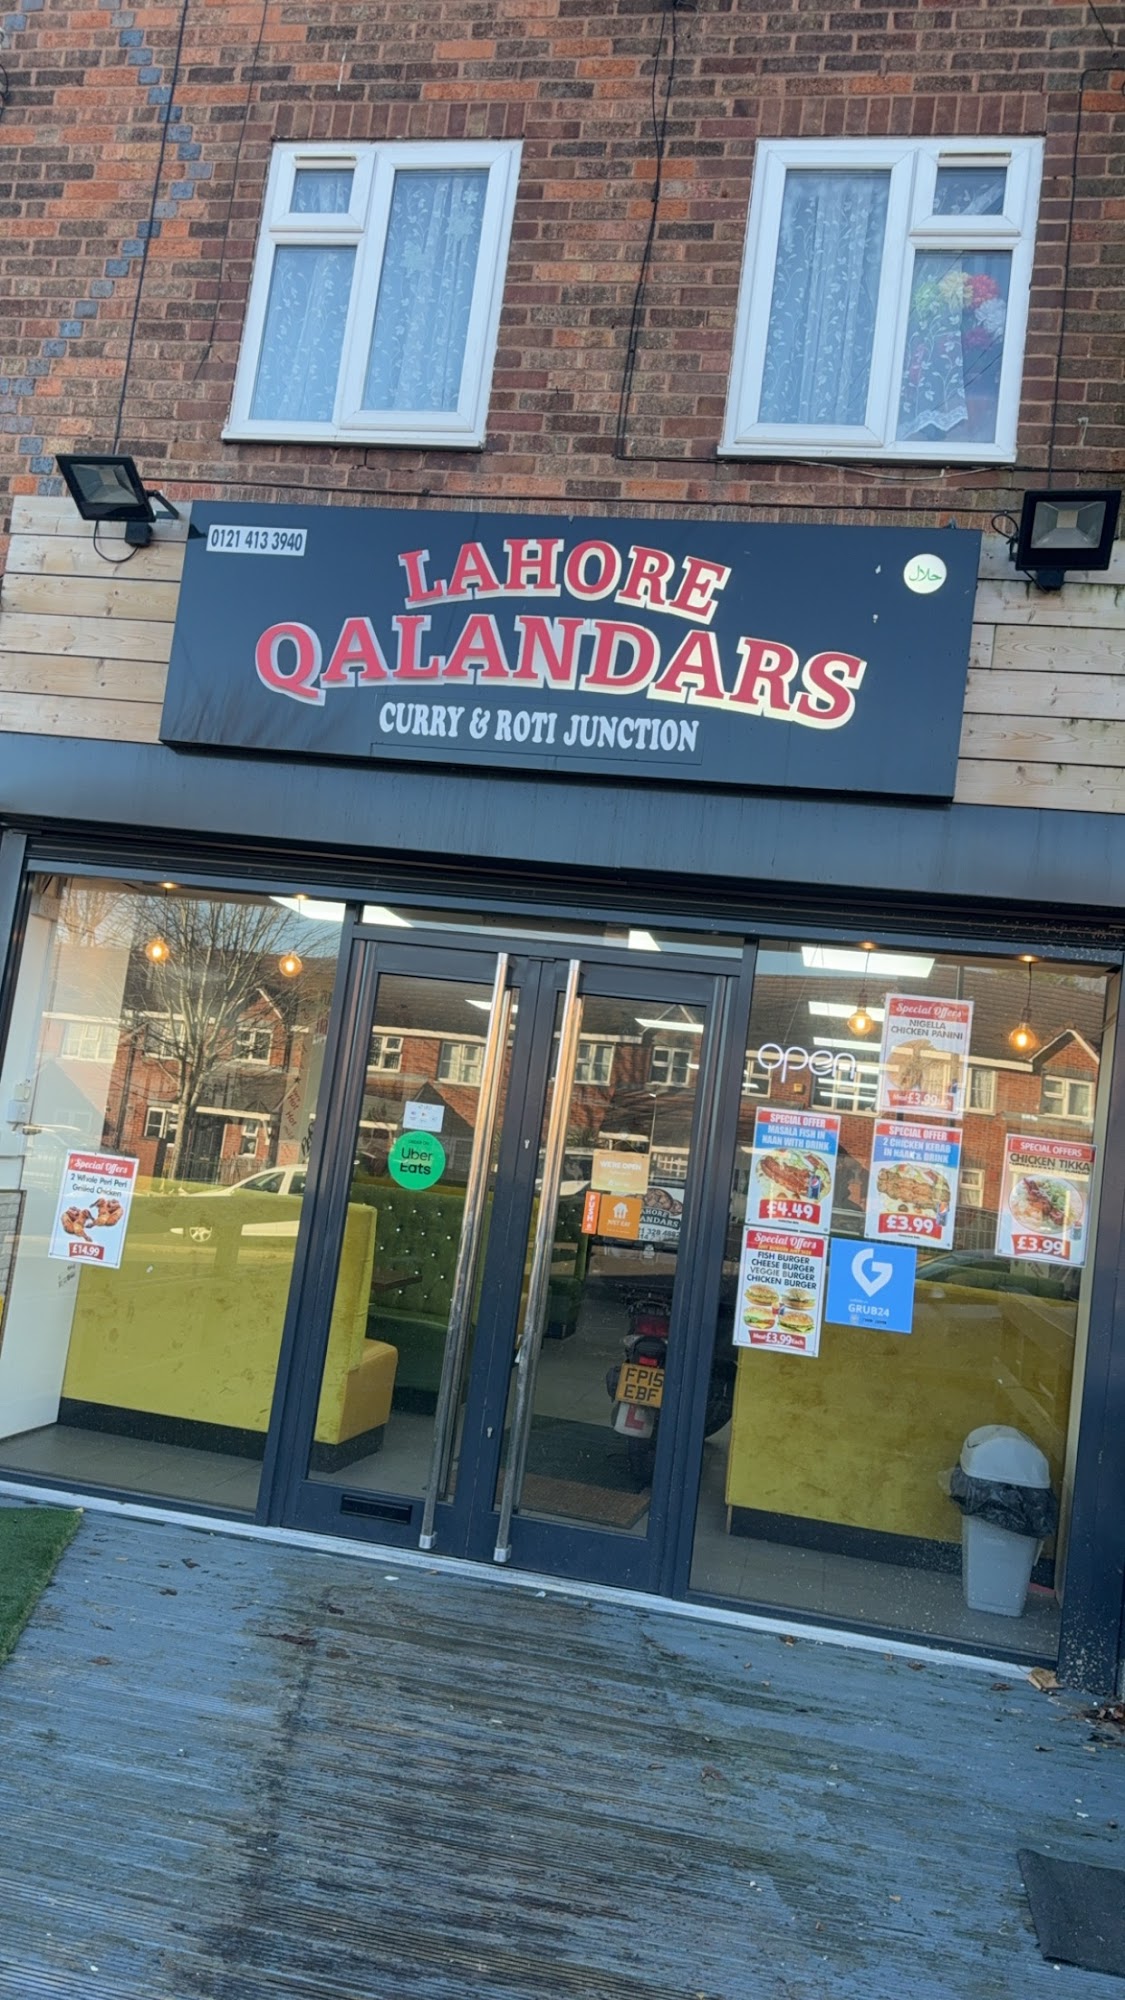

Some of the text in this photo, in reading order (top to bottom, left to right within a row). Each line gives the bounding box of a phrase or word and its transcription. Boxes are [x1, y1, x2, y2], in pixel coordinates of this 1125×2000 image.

[211, 529, 303, 551] 0121 413 3940
[908, 564, 943, 582] حلال
[398, 539, 731, 625] LAHORE
[255, 614, 868, 729] QALANDARS
[379, 702, 699, 751] CURRY & ROTI JUNCTION
[896, 1002, 962, 1019] Special Offers
[909, 1019, 946, 1029] NIGELLA
[891, 1026, 963, 1040] CHICKEN PANINI
[758, 1043, 856, 1083] open
[907, 1092, 938, 1105] £3.99
[770, 1113, 825, 1128] SPECIAL OFFER
[768, 1125, 825, 1139] MASALA FISH IN
[889, 1126, 947, 1140] SPECIAL OFFER
[762, 1135, 829, 1151] NAAN WITH DRINK
[889, 1139, 924, 1150] CHICKEN
[925, 1143, 952, 1153] KEBAB
[1020, 1142, 1082, 1157] SPECIAL OFFERS
[401, 1147, 432, 1161] Uber
[884, 1148, 892, 1156] IN
[924, 1153, 949, 1163] DRINK
[74, 1159, 128, 1174] Special Offers
[400, 1163, 431, 1175] Eats
[623, 1162, 641, 1171] OPEN
[1010, 1153, 1056, 1166] CHICKEN
[1060, 1160, 1090, 1171] TIKKA
[77, 1174, 98, 1184] Whole
[99, 1177, 113, 1186] Peri
[114, 1179, 128, 1188] Peri
[72, 1184, 122, 1197] Grilled Chicken
[586, 1195, 595, 1222] PUSH
[640, 1208, 668, 1217] AHORE
[767, 1201, 813, 1219] £4.49
[640, 1216, 679, 1228] ANDARS
[886, 1215, 933, 1234] £3.99
[755, 1233, 789, 1245] Special
[790, 1238, 817, 1250] Offers
[1017, 1236, 1064, 1255] £3.99
[72, 1245, 100, 1256] £14.99
[758, 1252, 810, 1264] FISH BURGER
[751, 1259, 815, 1272] CHEESE BURGER
[750, 1267, 815, 1280] VEGGIE BURGER
[747, 1274, 817, 1289] CHICKEN BURGER
[848, 1303, 890, 1317] GRUB24
[766, 1333, 791, 1344] £3.99
[625, 1368, 664, 1387] FP15
[623, 1384, 659, 1401] EBF
[624, 1404, 644, 1430] L
